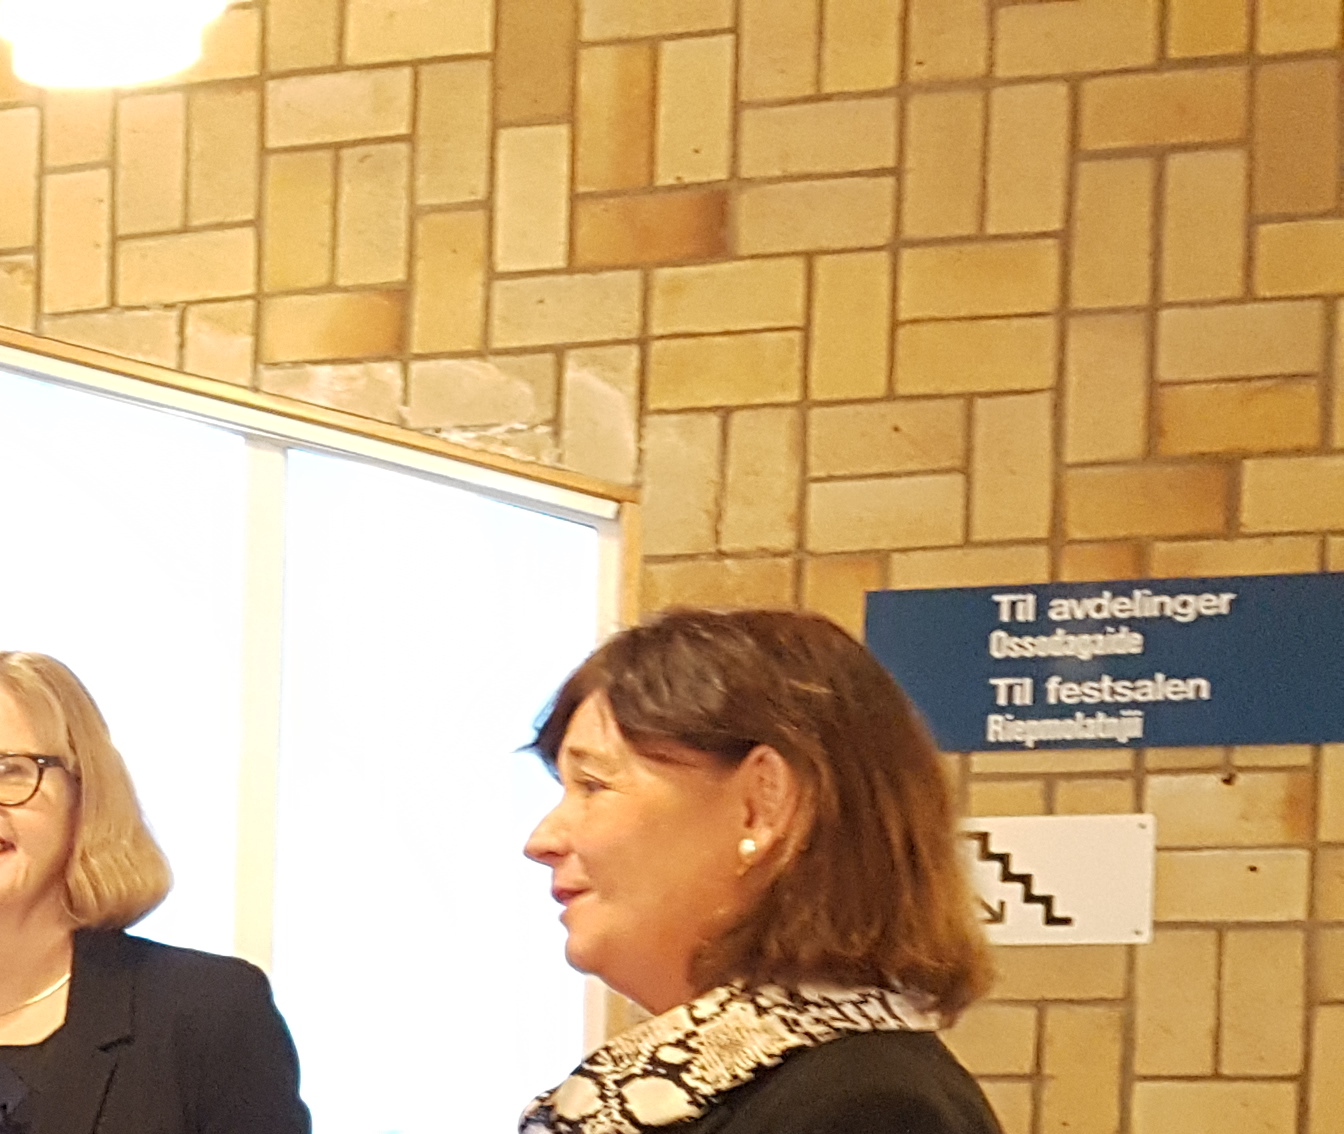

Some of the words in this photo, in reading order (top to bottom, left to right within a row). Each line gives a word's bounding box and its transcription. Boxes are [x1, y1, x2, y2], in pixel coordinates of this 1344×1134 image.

[991, 593, 1037, 622] Til
[1048, 589, 1237, 622] avdelinger
[988, 677, 1034, 706] Til
[1045, 673, 1210, 704] festsalen
